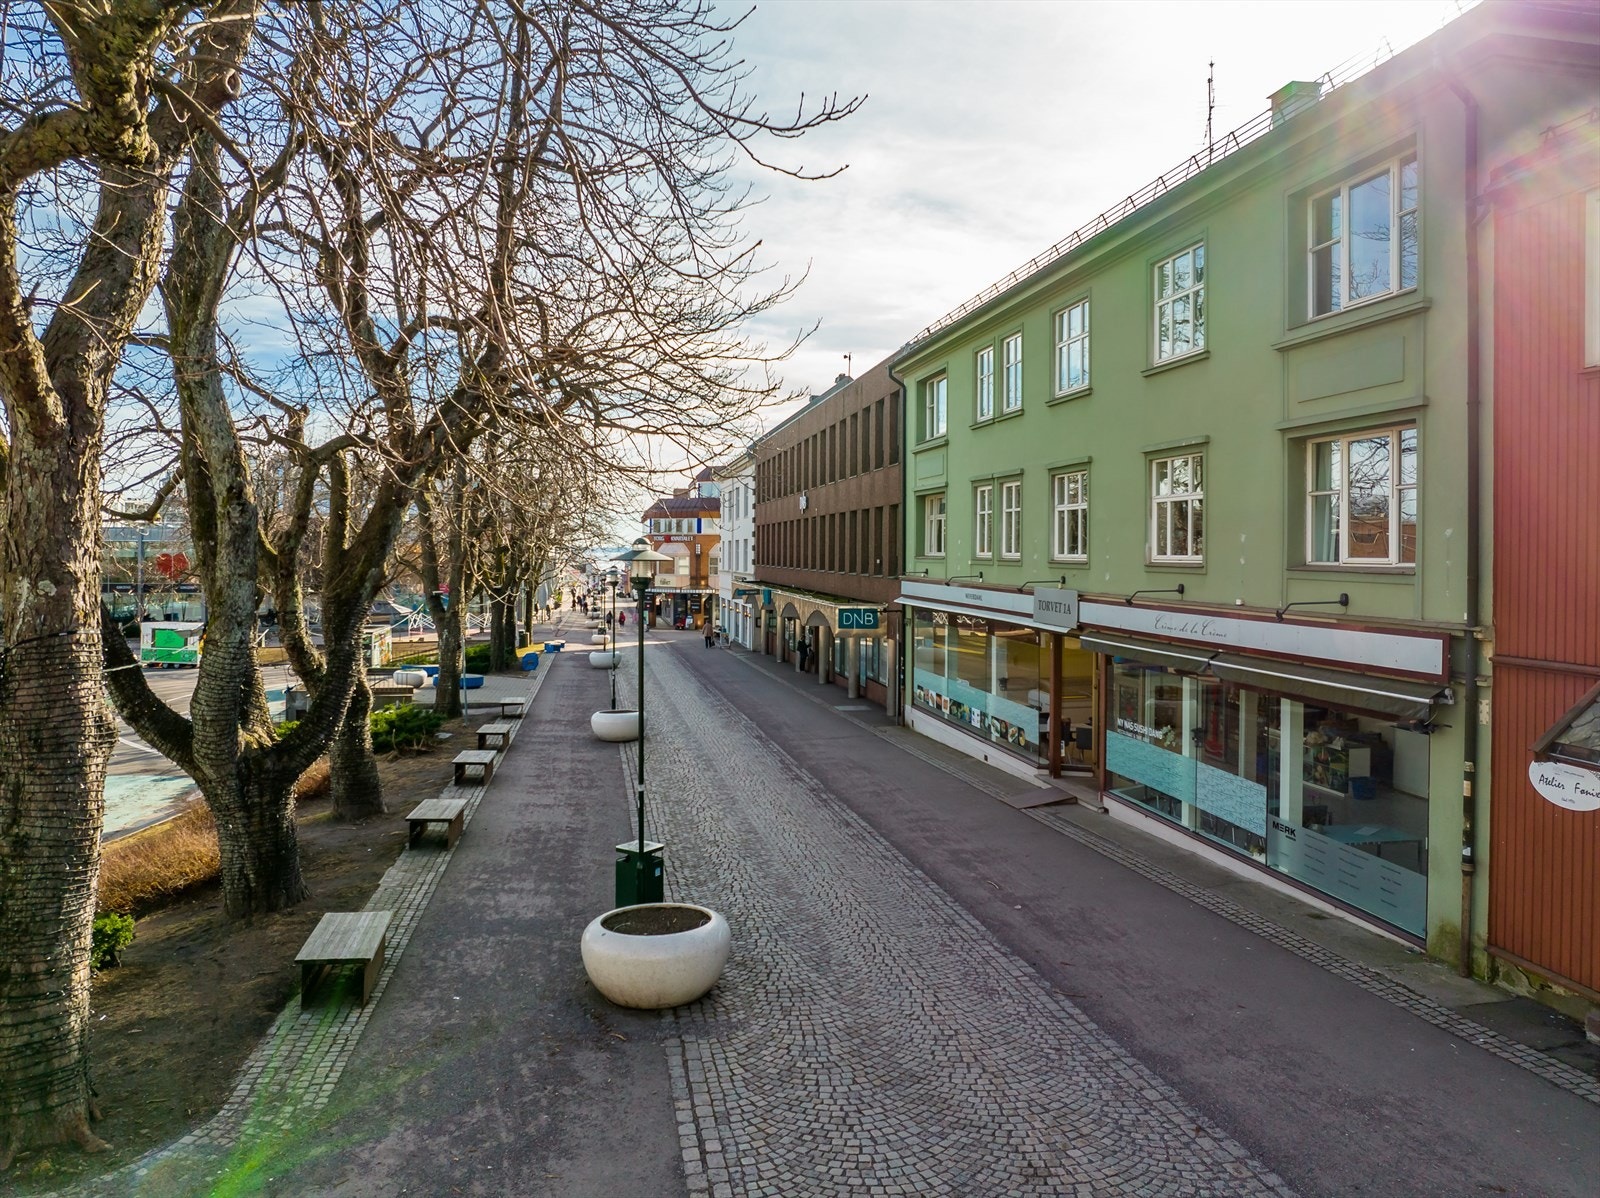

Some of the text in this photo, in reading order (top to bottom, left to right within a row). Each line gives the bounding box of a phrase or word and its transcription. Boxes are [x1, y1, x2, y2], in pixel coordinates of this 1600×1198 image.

[1038, 600, 1071, 615] TORVET 1A
[843, 609, 874, 629] DNB
[1179, 622, 1188, 633] de
[1190, 622, 1198, 634] la
[1539, 773, 1565, 790] Atelier
[1272, 820, 1297, 837] MERK
